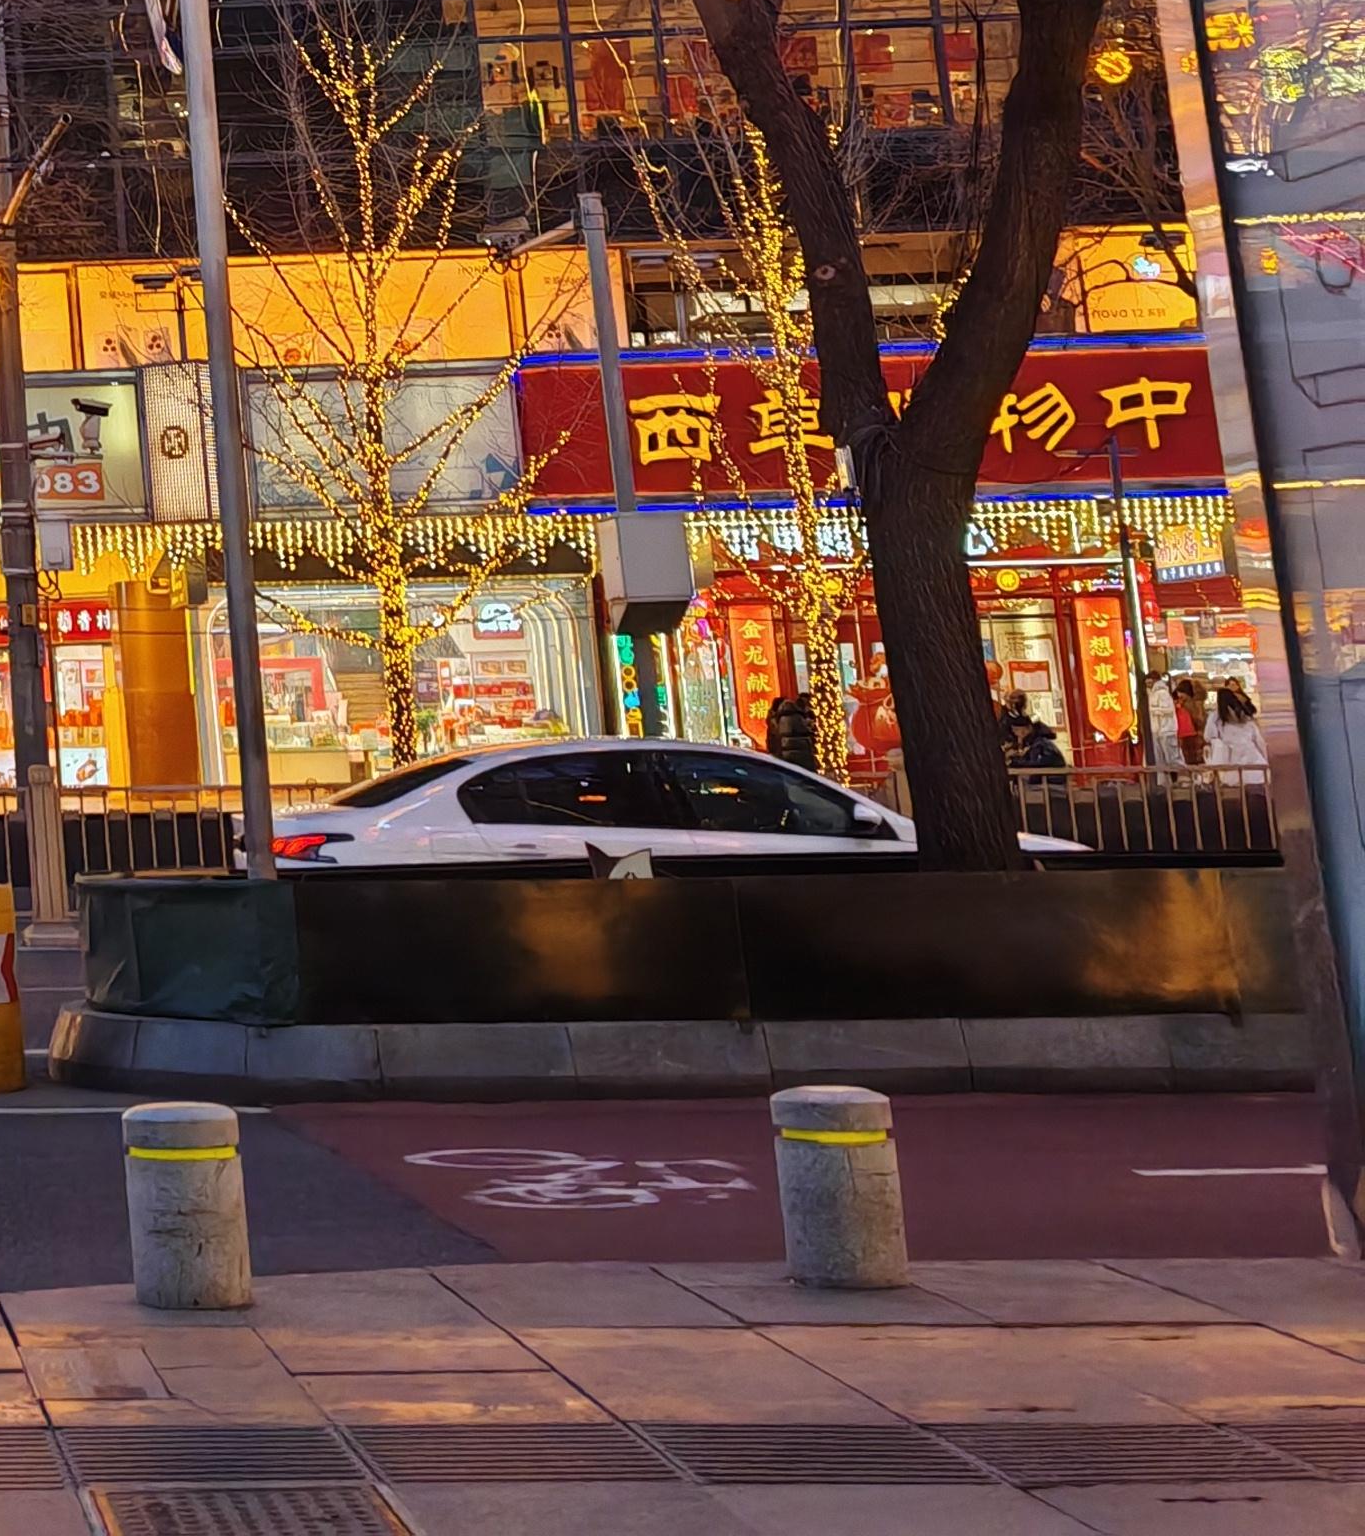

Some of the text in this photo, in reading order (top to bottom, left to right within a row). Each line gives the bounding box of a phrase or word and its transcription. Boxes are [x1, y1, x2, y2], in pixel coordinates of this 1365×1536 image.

[1133, 308, 1144, 318] 12
[629, 376, 1192, 465] 西单物中
[739, 619, 773, 720] 金龙献瑞
[1085, 611, 1122, 713] 心想事成
